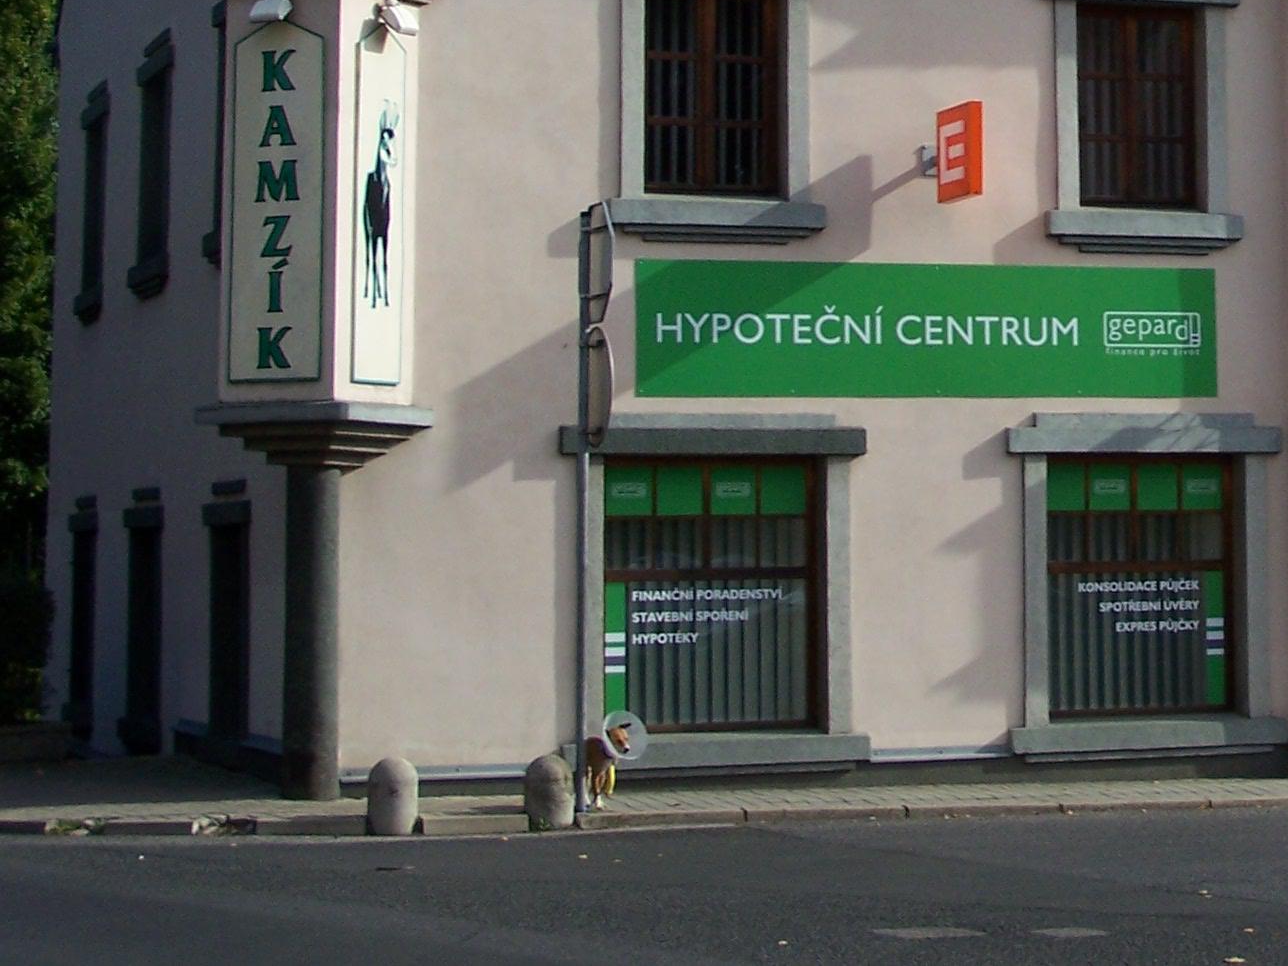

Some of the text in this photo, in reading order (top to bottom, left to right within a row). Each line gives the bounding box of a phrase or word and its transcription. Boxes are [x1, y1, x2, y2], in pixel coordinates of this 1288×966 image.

[254, 48, 301, 370] KAMZÍK
[655, 305, 1080, 346] HYPOTEČNÍ CENTRUM
[1108, 318, 1188, 341] gepard
[632, 586, 784, 601] FINANČNÍ PORADENSTVÍ
[1078, 580, 1158, 593] KONSOLIDACE
[1099, 599, 1161, 612] SPOTŘEBNÍ
[632, 607, 749, 623] STAVEBNÍ SPOŘENÍ
[1115, 621, 1157, 632] EXPRES
[632, 631, 699, 645] HYPOTÉKY
